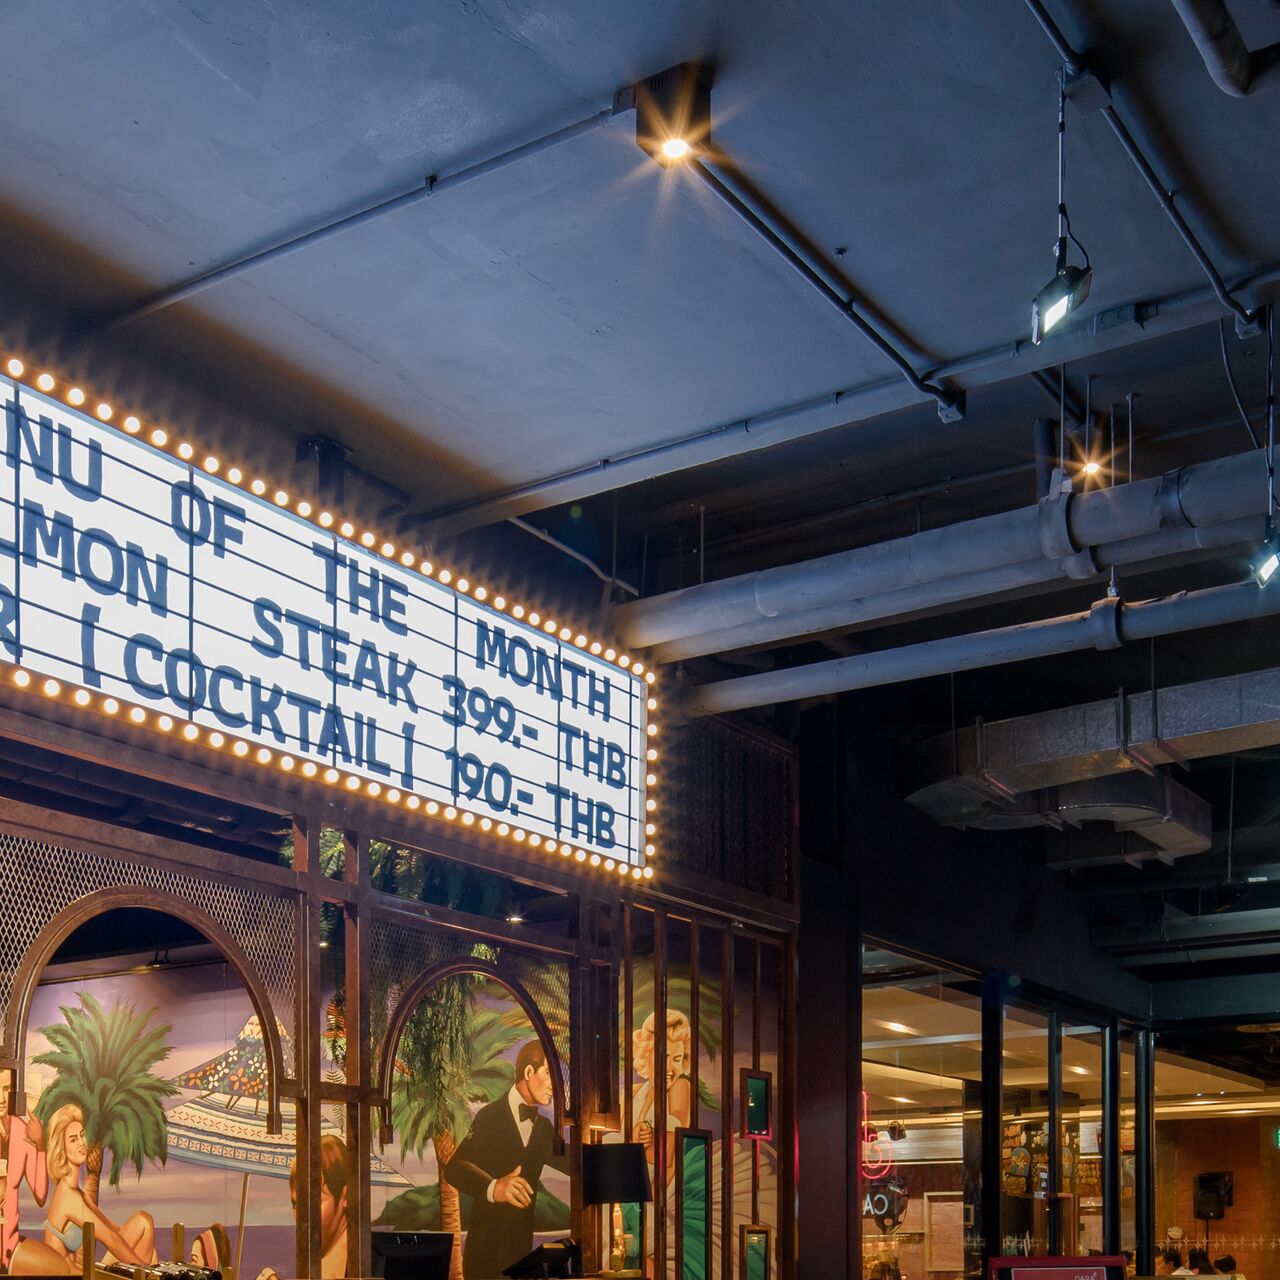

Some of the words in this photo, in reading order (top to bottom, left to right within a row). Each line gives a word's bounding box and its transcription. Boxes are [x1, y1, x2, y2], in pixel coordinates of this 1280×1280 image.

[171, 480, 246, 559] OF
[312, 541, 409, 637] THE
[476, 618, 612, 722] MONTH
[252, 597, 419, 713] STEAK
[442, 674, 539, 748] 399.-
[560, 722, 627, 790] THB
[124, 633, 391, 778] COCKTAIL
[445, 746, 535, 816] 190.-
[546, 782, 617, 849] THB
